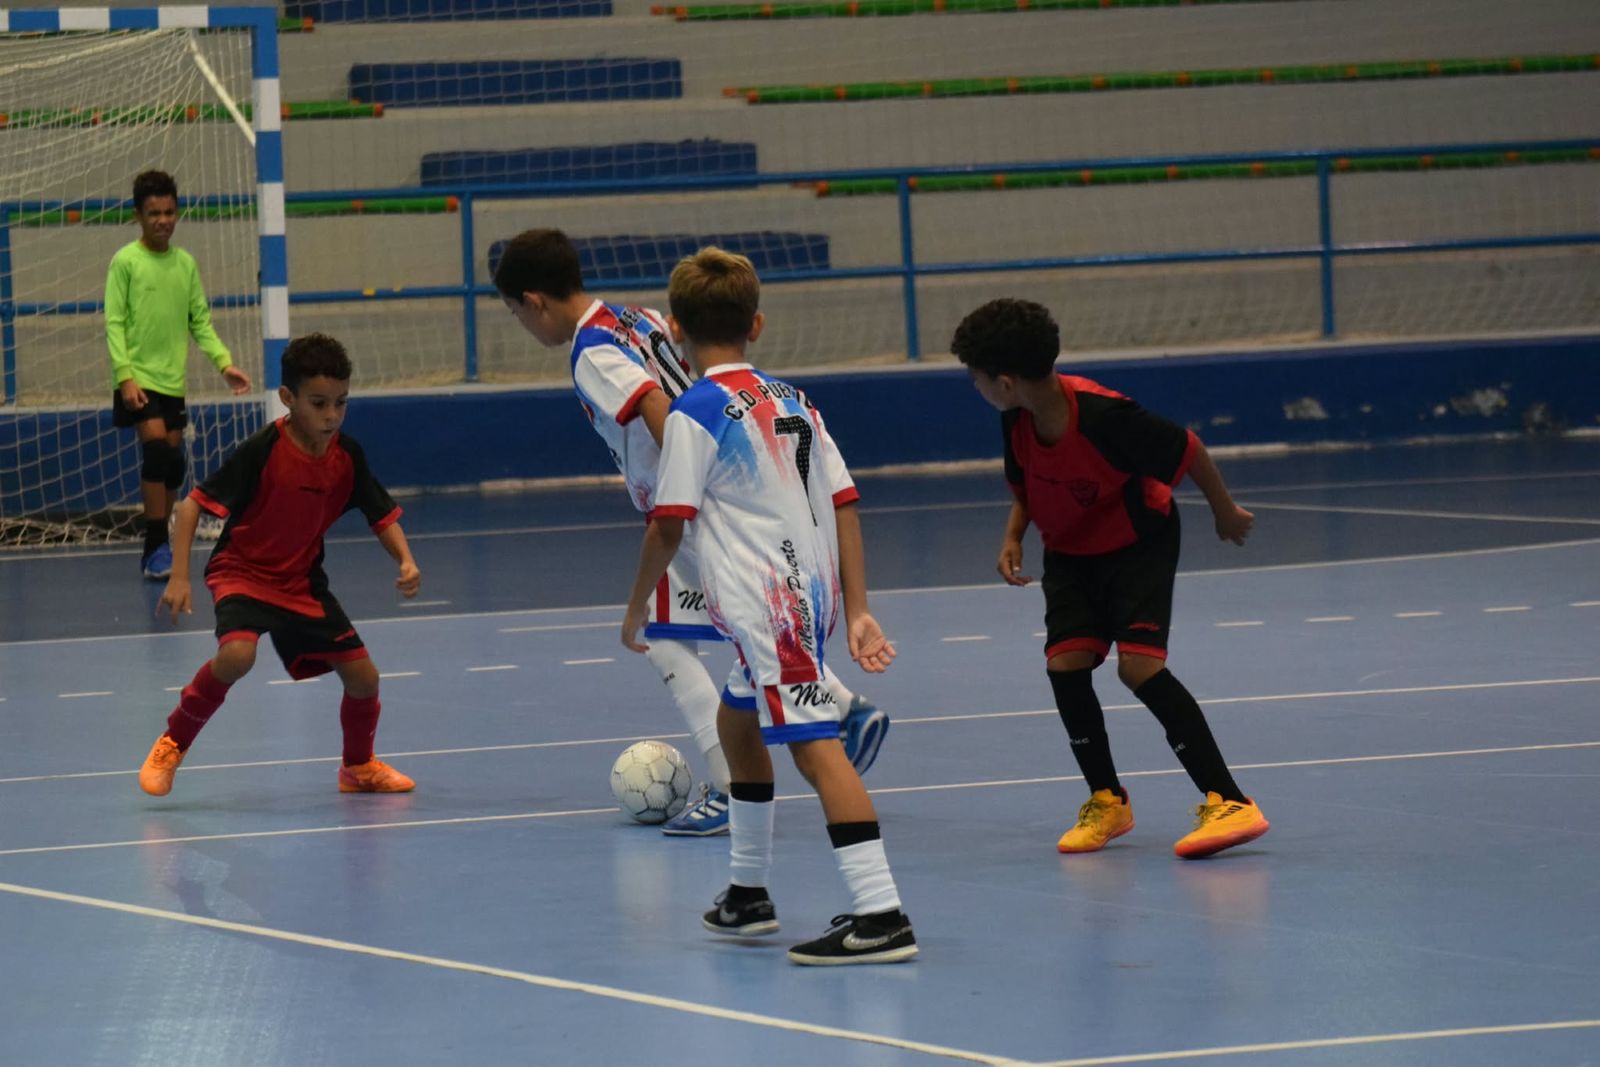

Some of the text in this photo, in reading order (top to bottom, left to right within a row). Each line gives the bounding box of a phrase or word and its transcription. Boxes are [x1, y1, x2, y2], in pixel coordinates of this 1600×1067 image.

[639, 329, 692, 400] 10
[774, 415, 818, 527] 7
[780, 538, 813, 653] Mucho Puerto
